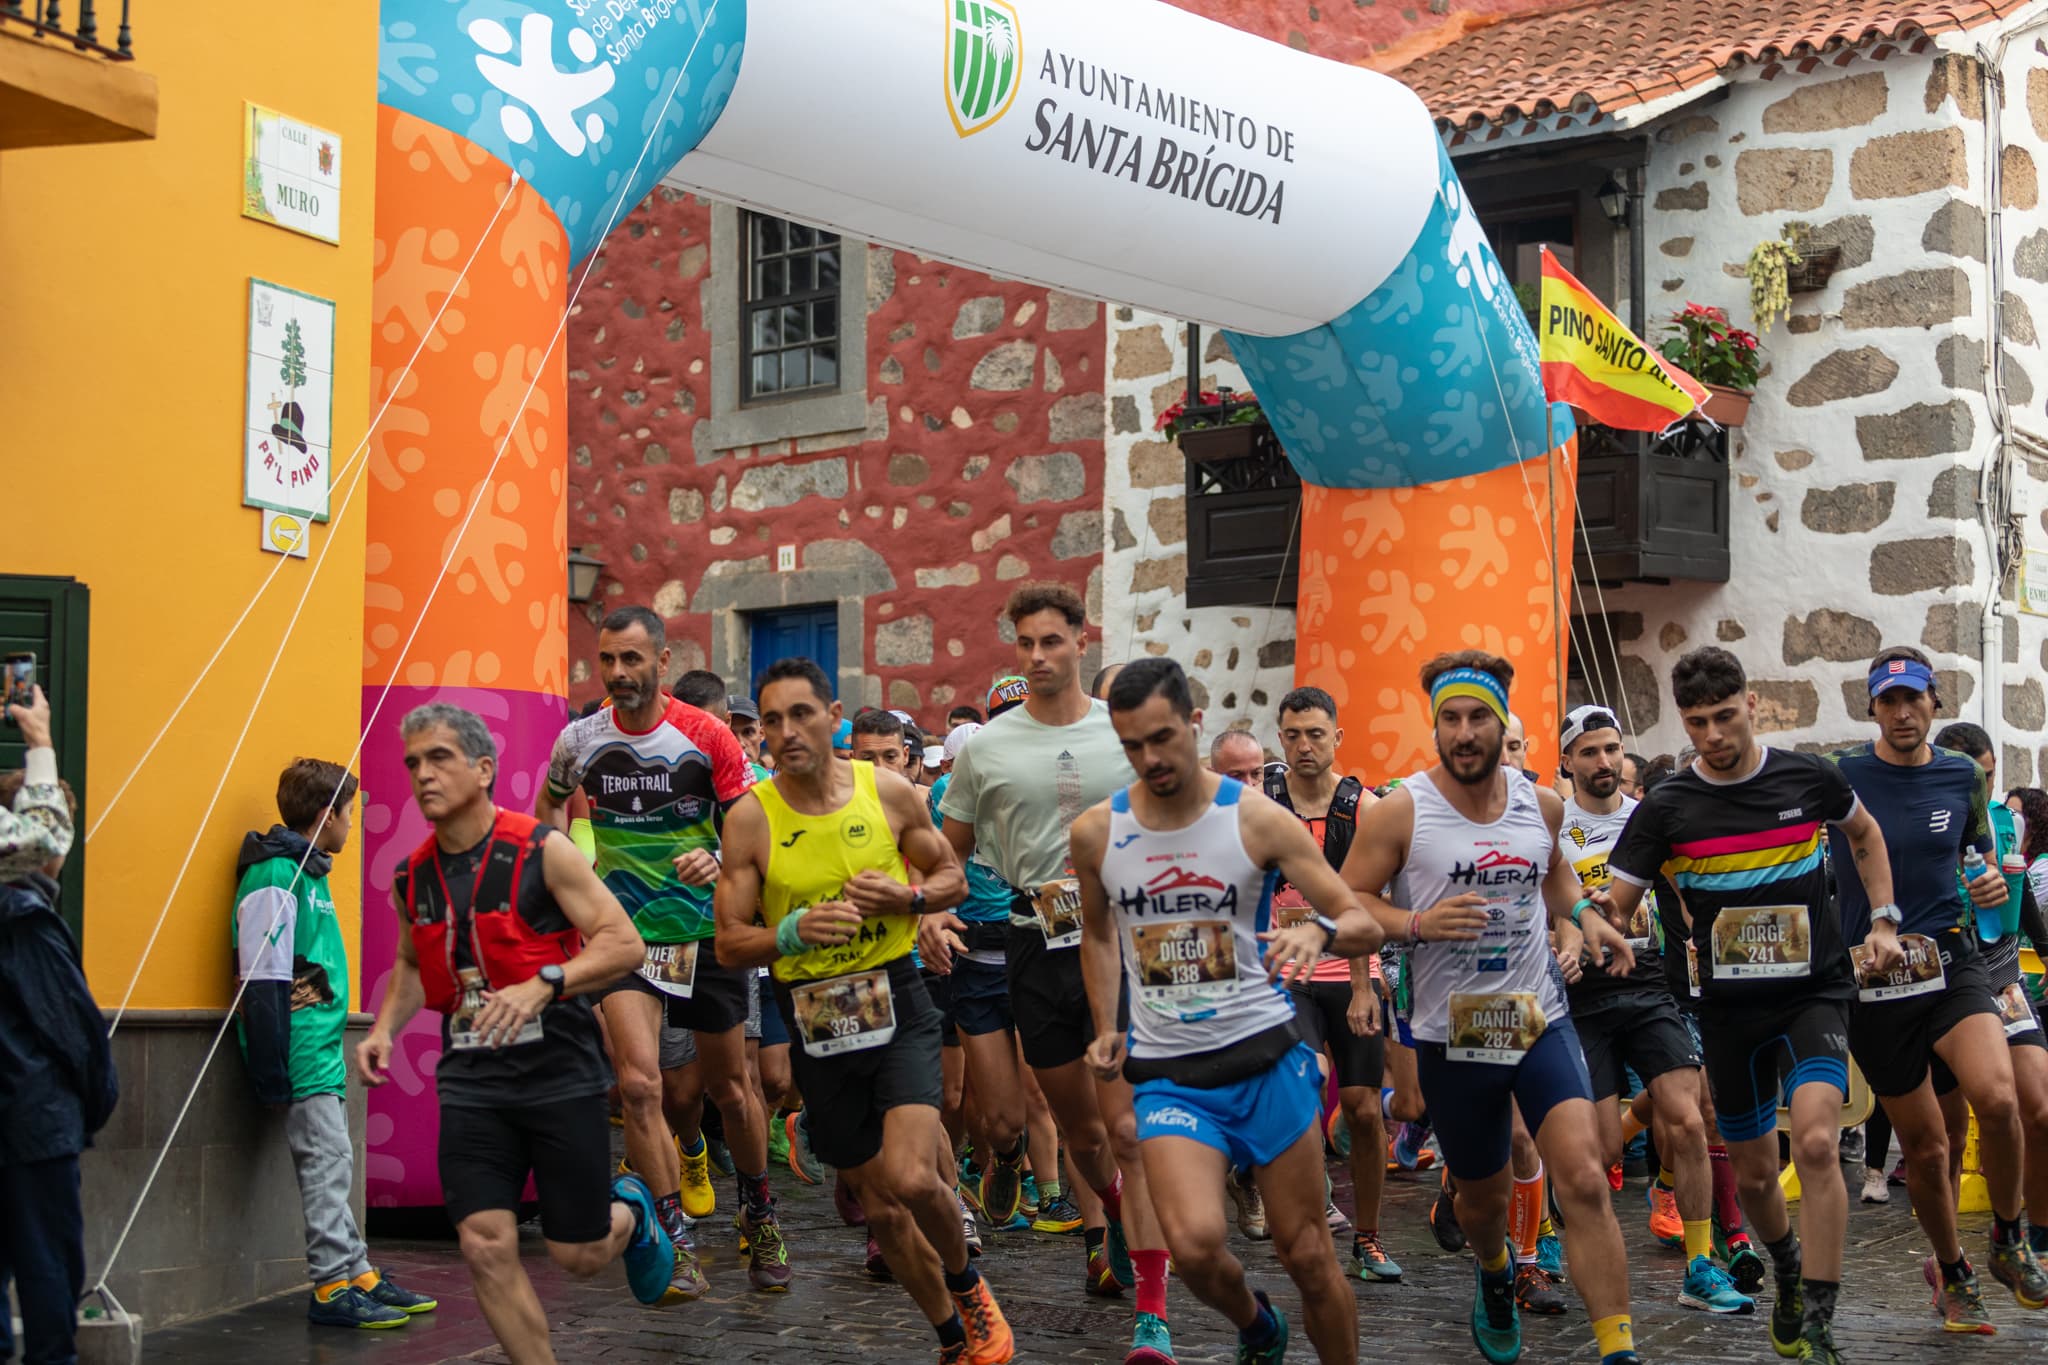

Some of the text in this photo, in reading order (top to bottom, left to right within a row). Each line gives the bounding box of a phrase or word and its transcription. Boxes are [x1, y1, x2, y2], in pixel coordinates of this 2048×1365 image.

[592, 15, 614, 39] de
[606, 20, 648, 65] Santa
[1040, 48, 1295, 164] AYUNTAMIENTO DE
[282, 125, 308, 145] CALLE
[1025, 97, 1285, 225] SANTA BRÍGIDA
[277, 183, 320, 217] MURO
[1549, 305, 1594, 346] PINO
[1595, 322, 1647, 372] SANTO
[291, 454, 320, 488] PINO
[998, 681, 1029, 701] WTF!
[601, 772, 673, 795] TEROR TRAIL
[1447, 861, 1539, 888] HILERA
[1118, 884, 1238, 917] HILERA
[1737, 924, 1787, 943] JORGE
[1160, 938, 1208, 963] DIEGO
[1748, 946, 1776, 963] 241
[1899, 947, 1928, 967] TAN
[1170, 963, 1200, 985] 138
[1887, 969, 1913, 986] 164
[830, 1015, 860, 1038] 325
[1472, 1010, 1527, 1029] DANIEL
[1484, 1031, 1513, 1049] 282
